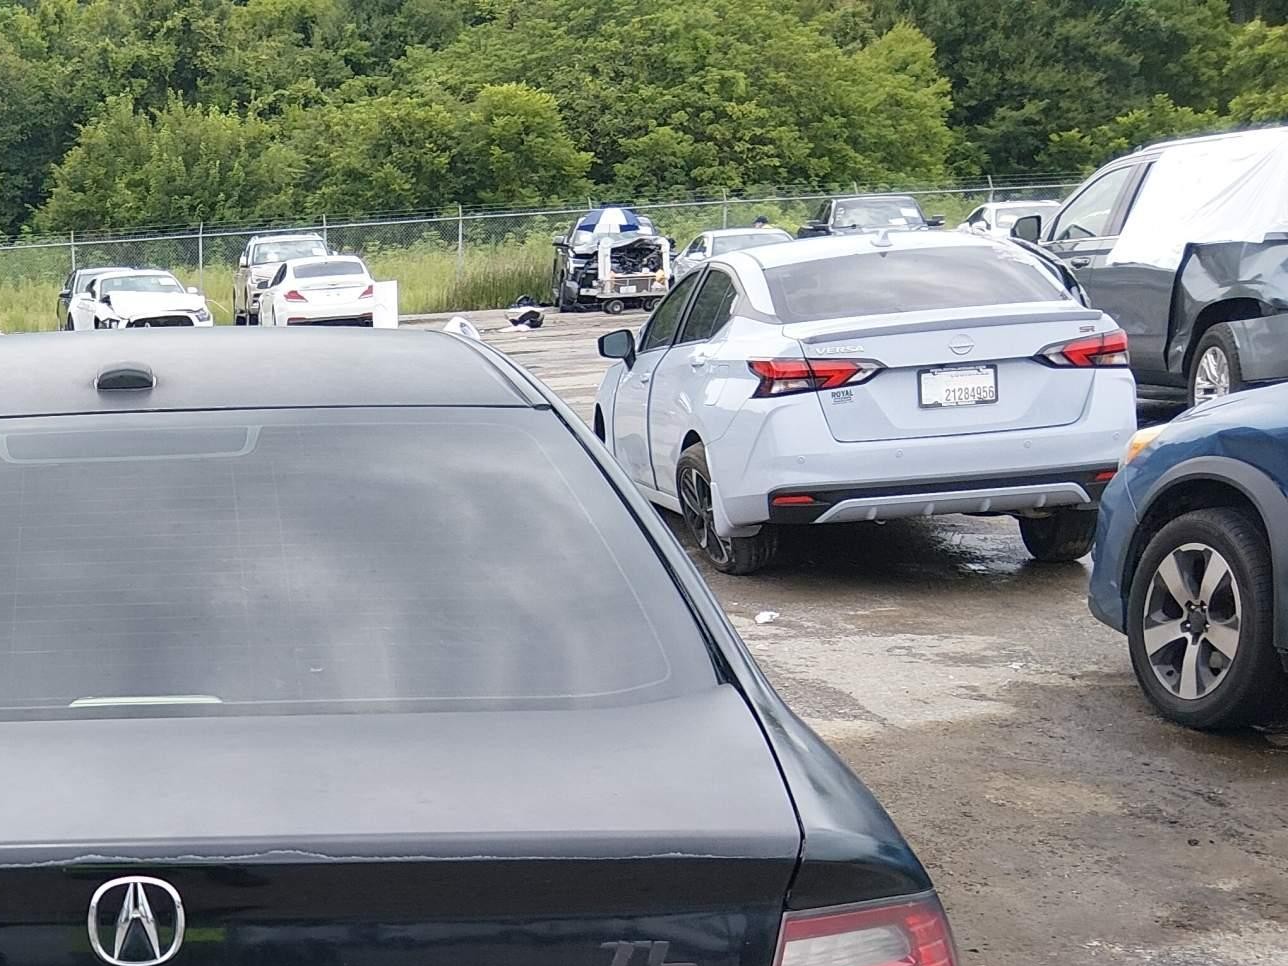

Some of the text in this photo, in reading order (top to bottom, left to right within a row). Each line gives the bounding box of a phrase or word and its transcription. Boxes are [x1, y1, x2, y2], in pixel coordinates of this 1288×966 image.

[815, 345, 864, 355] VERSA
[831, 389, 854, 398] ROYAL
[945, 385, 995, 402] 21284956
